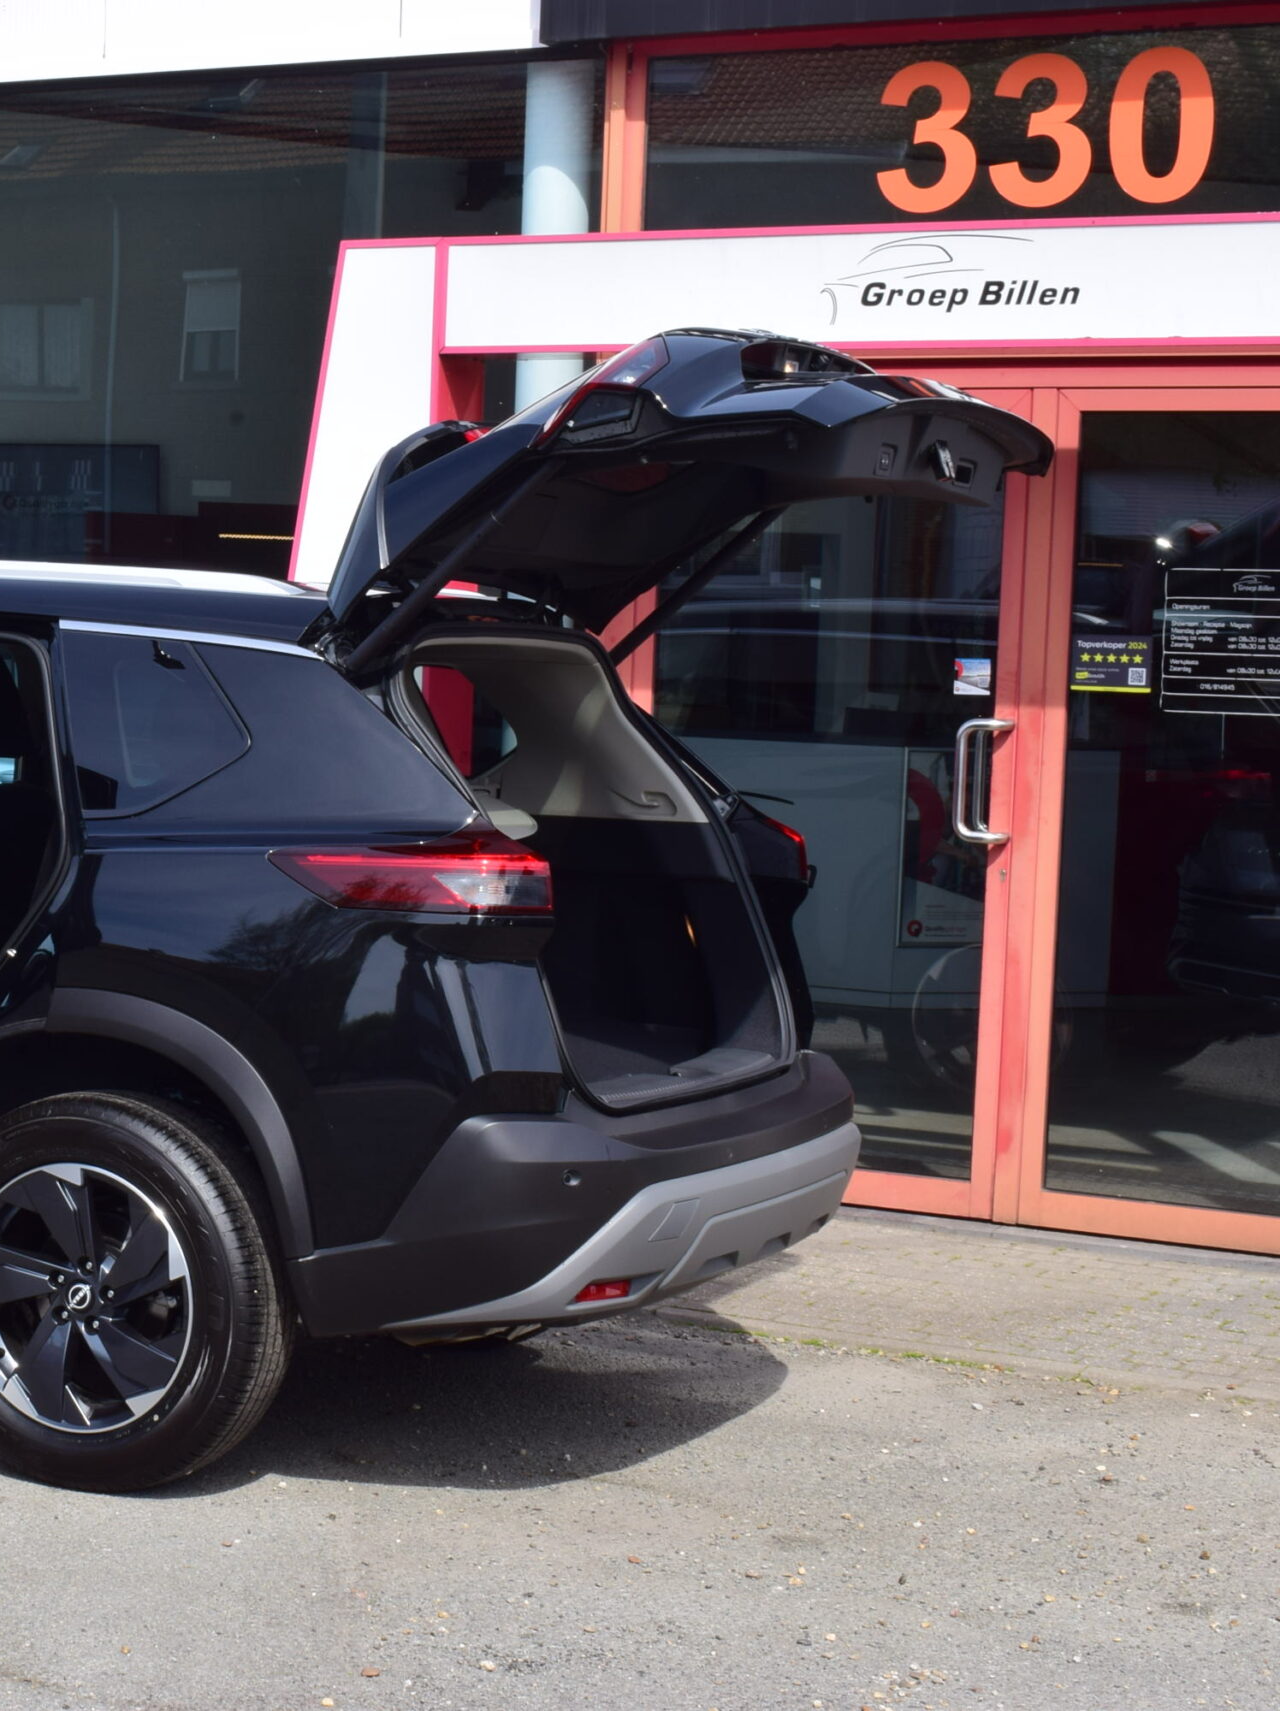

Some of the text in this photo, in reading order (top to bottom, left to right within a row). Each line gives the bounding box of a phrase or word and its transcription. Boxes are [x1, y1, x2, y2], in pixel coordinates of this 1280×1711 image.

[876, 46, 1215, 214] 330
[860, 280, 1081, 313] Groep Billen
[1077, 640, 1148, 650] Topverkoper 2024
